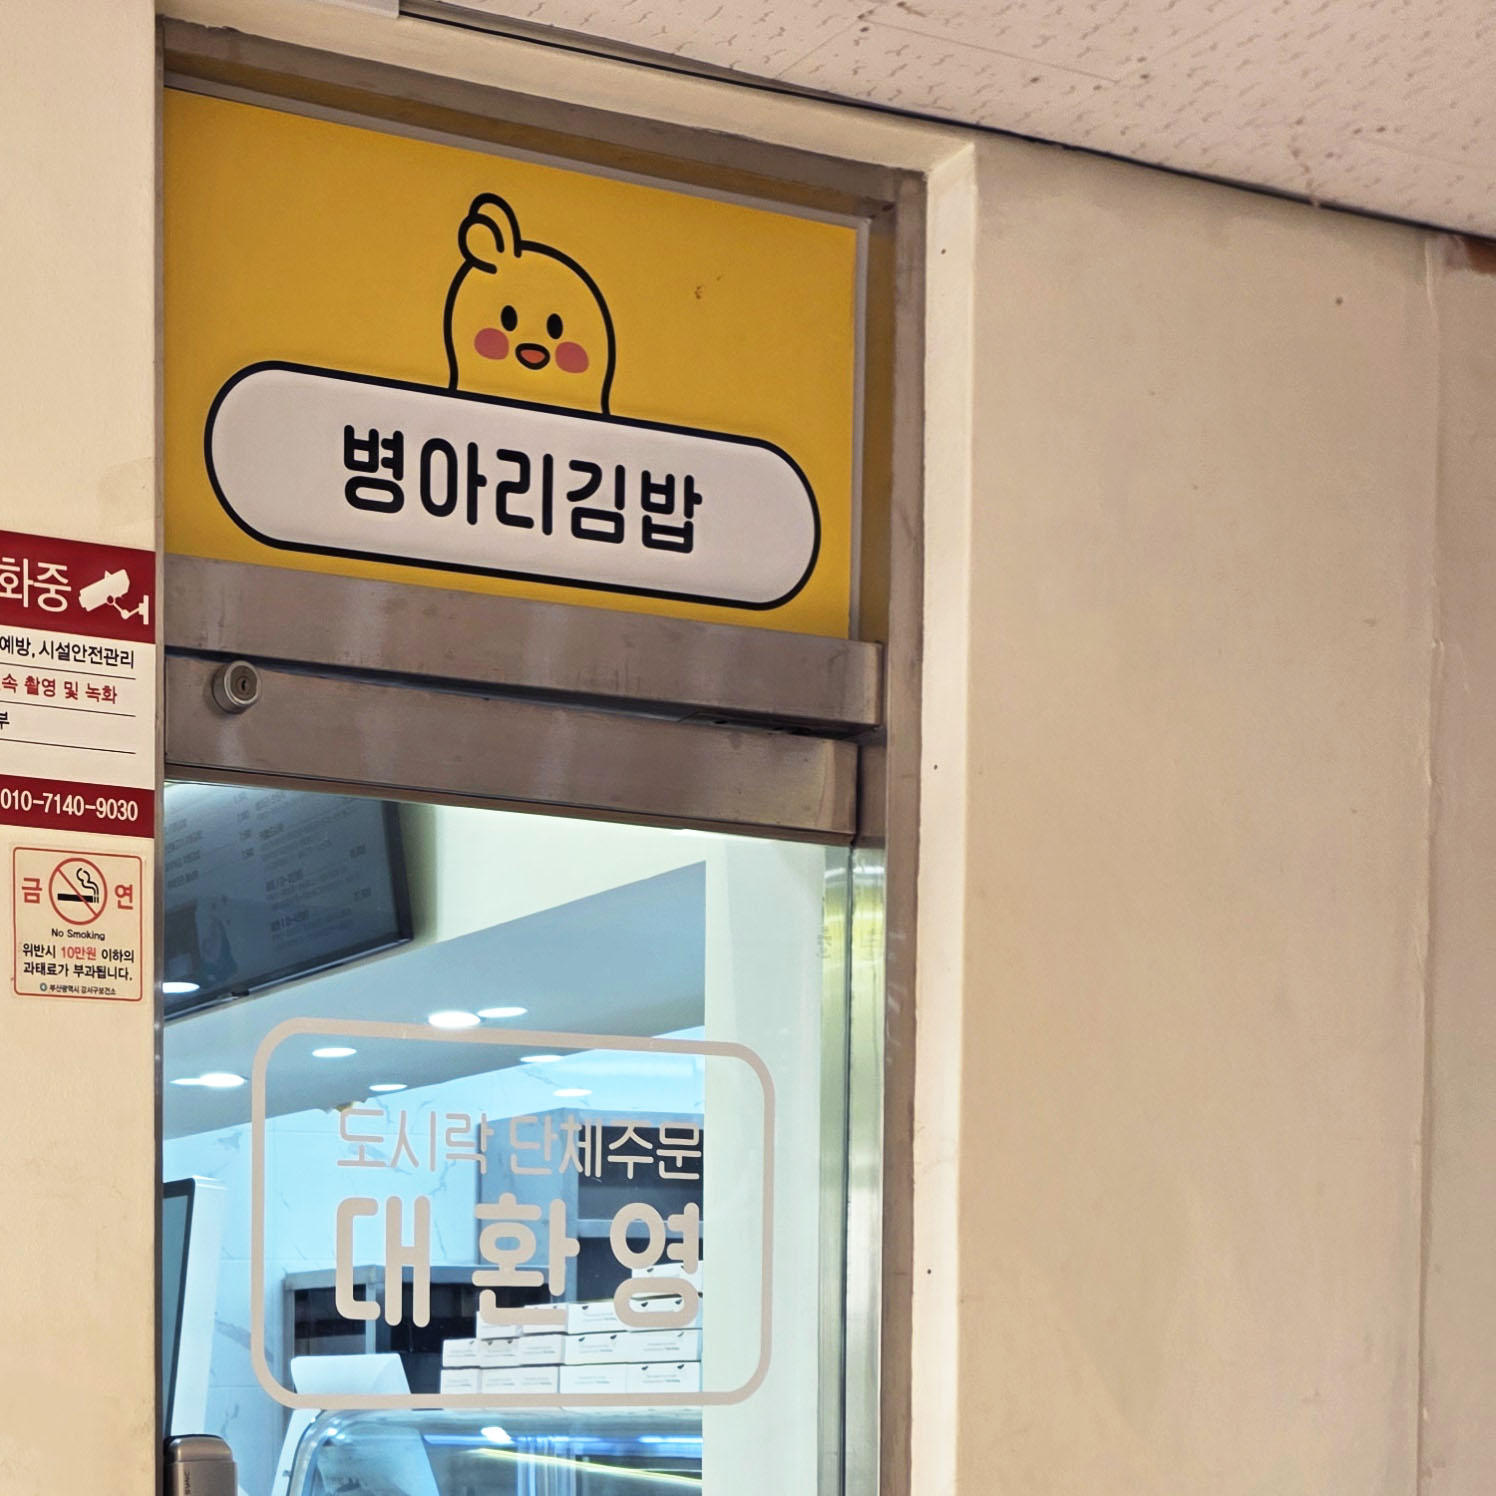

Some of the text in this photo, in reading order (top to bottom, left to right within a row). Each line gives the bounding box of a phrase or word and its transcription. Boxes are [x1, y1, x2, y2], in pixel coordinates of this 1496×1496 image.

[343, 424, 703, 554] 병아리김밥
[24, 675, 56, 699] 촬영
[63, 681, 79, 700] 및
[84, 682, 118, 705] 녹화
[0, 787, 139, 822] 010-7140-9030
[21, 877, 134, 910] 금 연
[51, 928, 106, 941] No Smoking
[22, 943, 135, 963] 위반시 10만원 이하의
[23, 961, 133, 981] 과태료가 부과됩니다.
[337, 1106, 701, 1180] 도시락 단체주문
